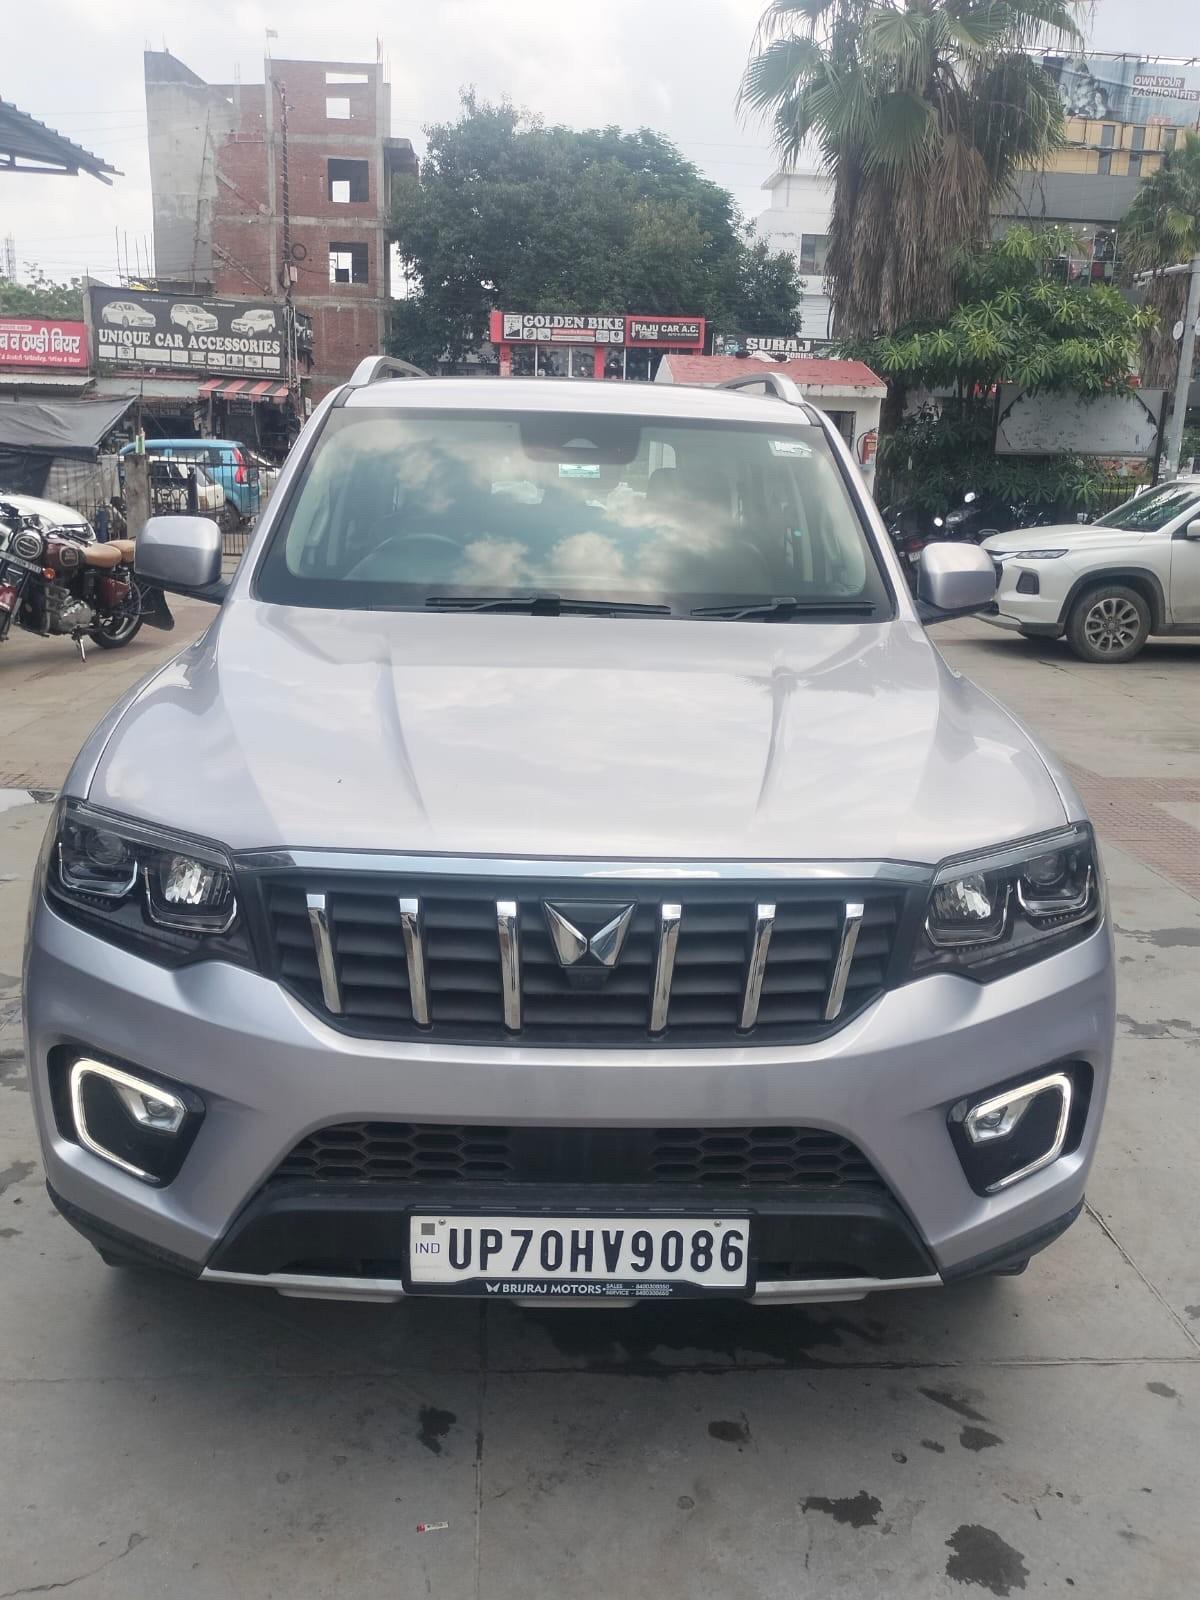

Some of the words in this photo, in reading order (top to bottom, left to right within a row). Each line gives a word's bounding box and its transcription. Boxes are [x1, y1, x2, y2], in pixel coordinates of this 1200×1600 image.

[1134, 76, 1157, 86] OWN
[1157, 77, 1182, 88] YOUR
[1132, 87, 1177, 98] FASHION
[523, 315, 584, 329] GOLDEN
[587, 317, 624, 330] BIKE
[635, 324, 659, 332] RAJU
[661, 324, 679, 333] CAR
[681, 325, 699, 333] A.C.
[51, 327, 81, 354] बियर
[98, 328, 151, 347] UNIQUE
[154, 332, 184, 348] CAR
[188, 334, 280, 355] ACCESSORIES
[746, 337, 811, 352] SURAJ
[415, 1242, 440, 1254] IND
[449, 1228, 744, 1273] UP70HV9086
[502, 1283, 548, 1294] BRIJRAJ
[550, 1284, 602, 1295] MOTORS
